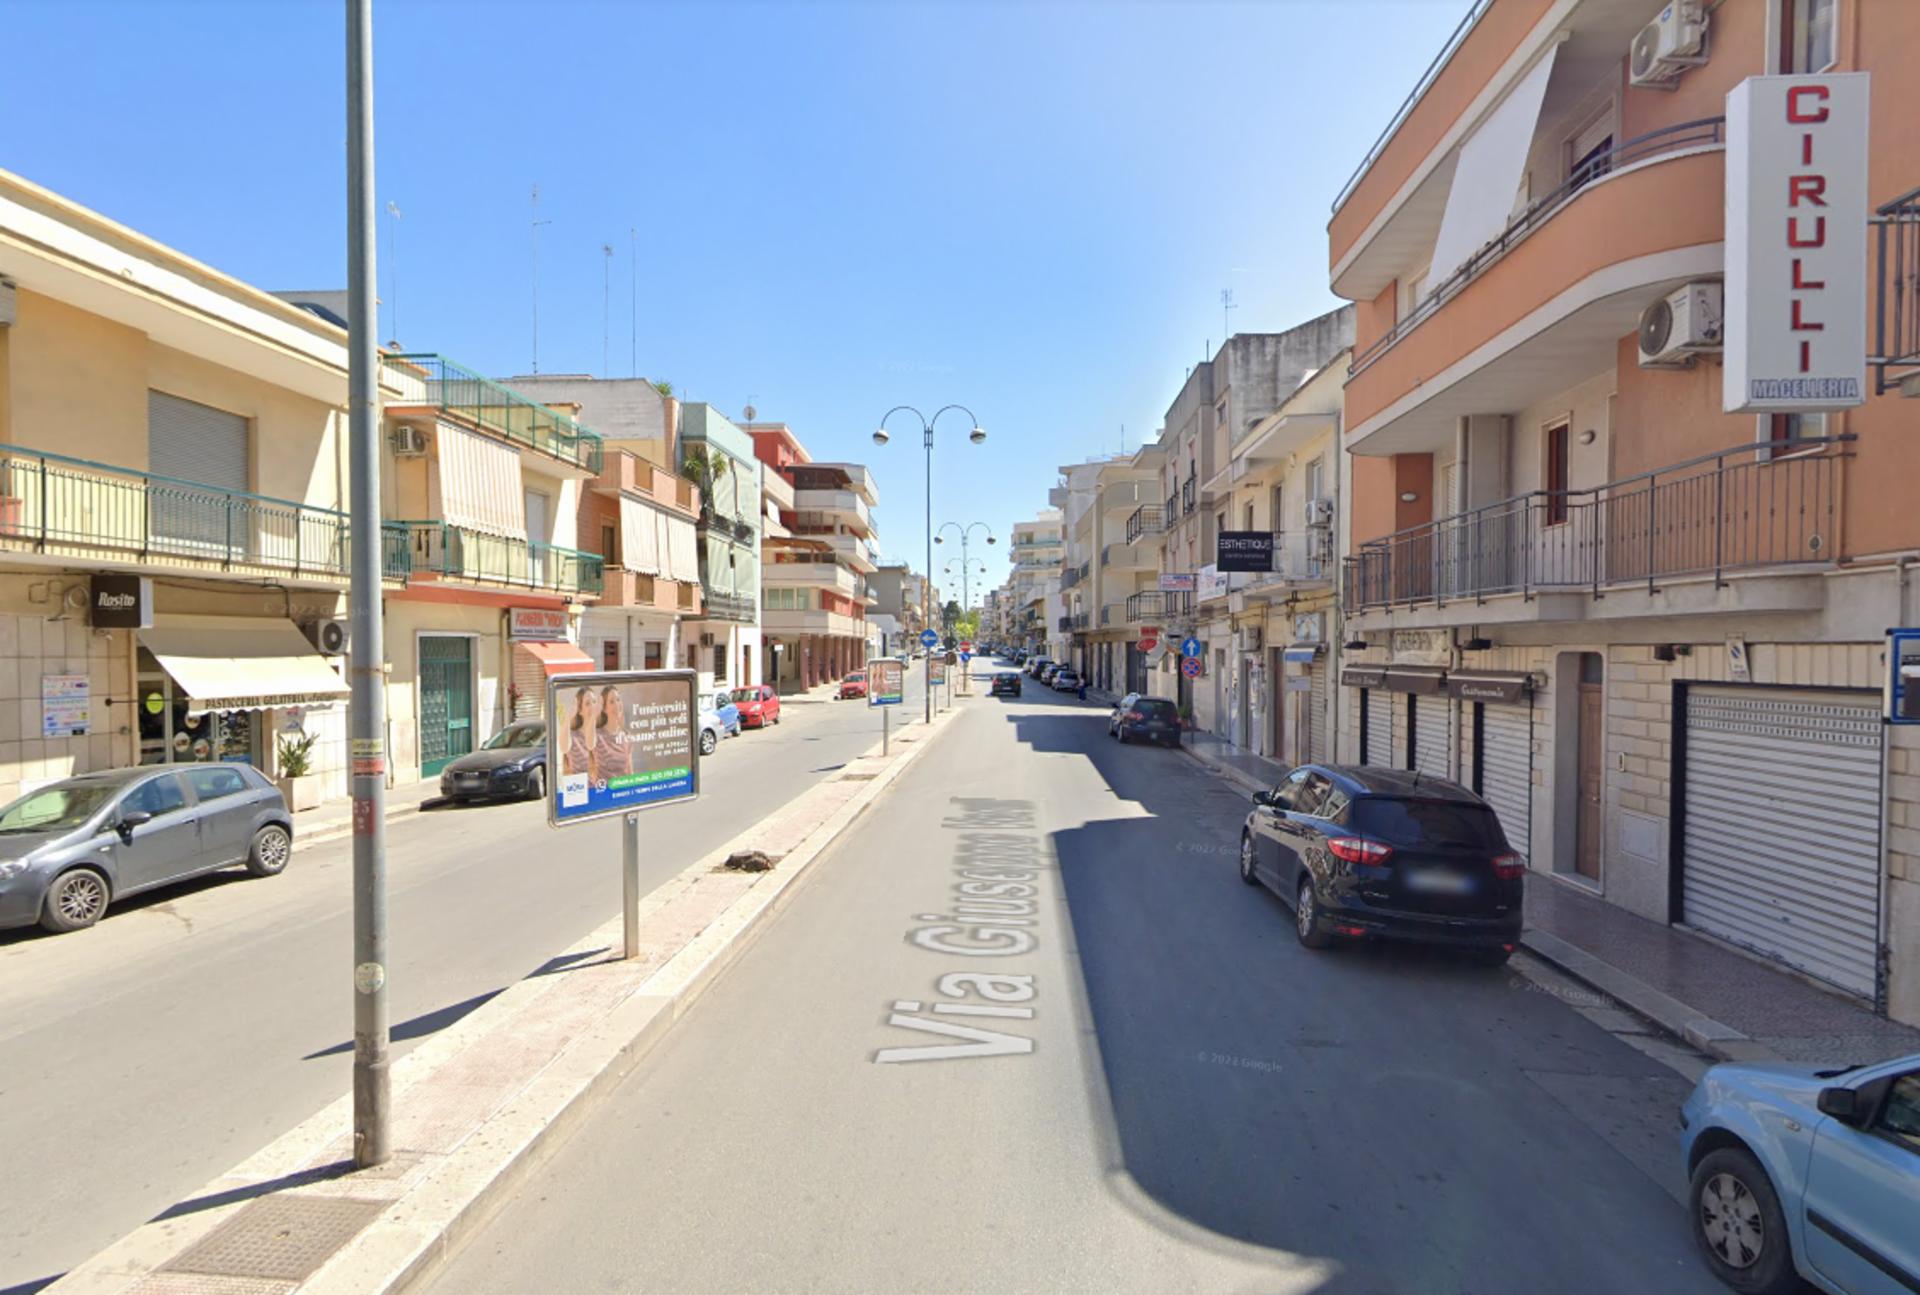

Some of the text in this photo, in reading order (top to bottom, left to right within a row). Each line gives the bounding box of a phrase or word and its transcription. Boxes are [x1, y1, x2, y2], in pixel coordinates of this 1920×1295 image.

[1786, 85, 1830, 372] CIRULLI
[1751, 377, 1859, 399] MACELLERIA
[205, 694, 259, 710] PASTICCERIA
[263, 692, 305, 706] GELATERIA
[631, 699, 688, 717] l'università
[659, 726, 689, 739] online
[872, 971, 1034, 1064] Via
